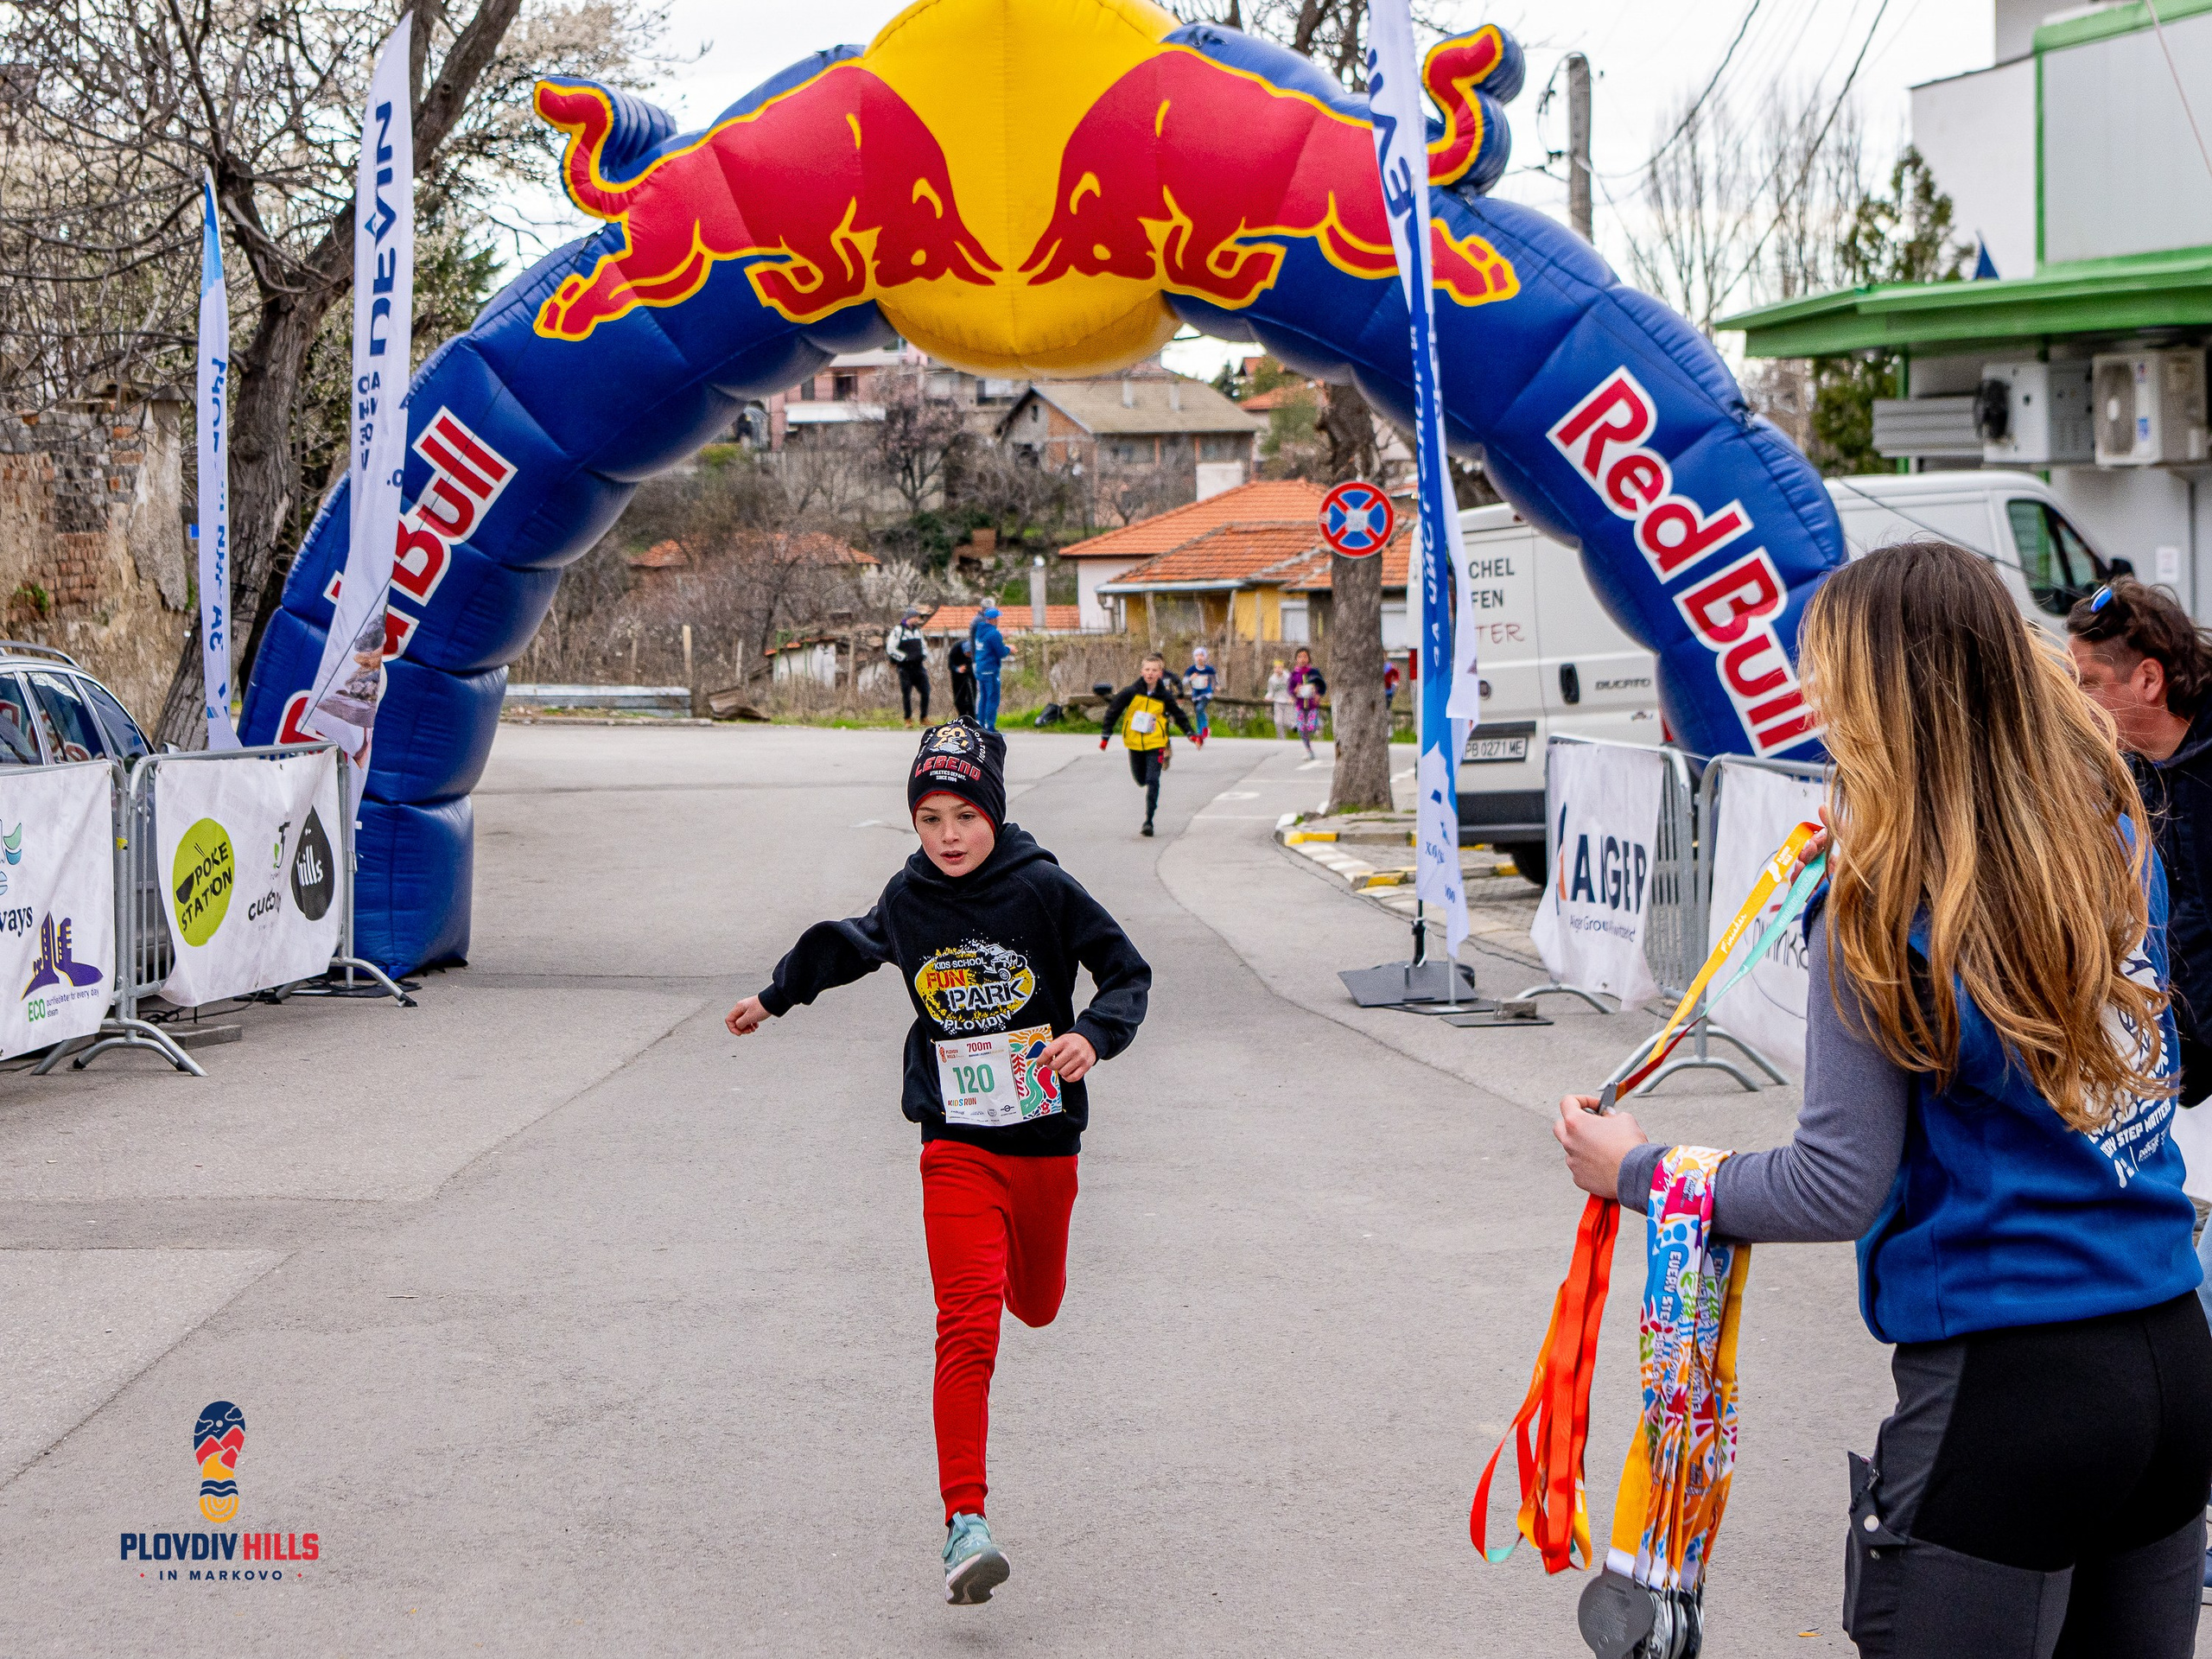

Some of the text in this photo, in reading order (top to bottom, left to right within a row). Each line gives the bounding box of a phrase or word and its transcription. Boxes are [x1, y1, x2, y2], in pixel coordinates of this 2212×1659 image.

[389, 415, 510, 600] Bull
[1469, 557, 1516, 580] CHEL
[1550, 370, 1821, 752] Red Bull
[1471, 588, 1504, 609] FEN
[1476, 622, 1525, 645] TER
[1595, 677, 1651, 690] DUCATO
[1481, 741, 1507, 756] 0271
[1509, 740, 1523, 755] ME
[194, 842, 229, 887] POKE
[296, 844, 324, 887] hills
[181, 867, 232, 932] STATION
[1720, 913, 1747, 954] Finisher
[934, 957, 988, 970] KIDS SCHOOL
[926, 969, 966, 989] FUN
[28, 998, 46, 1022] ECO
[77, 989, 90, 999] every
[948, 977, 1027, 1010] PARK
[944, 1010, 1014, 1031] PLOVDIV
[966, 1041, 992, 1052] 700m
[952, 1064, 995, 1095] 120
[963, 1097, 977, 1106] RUN
[2116, 1122, 2144, 1148] STEP
